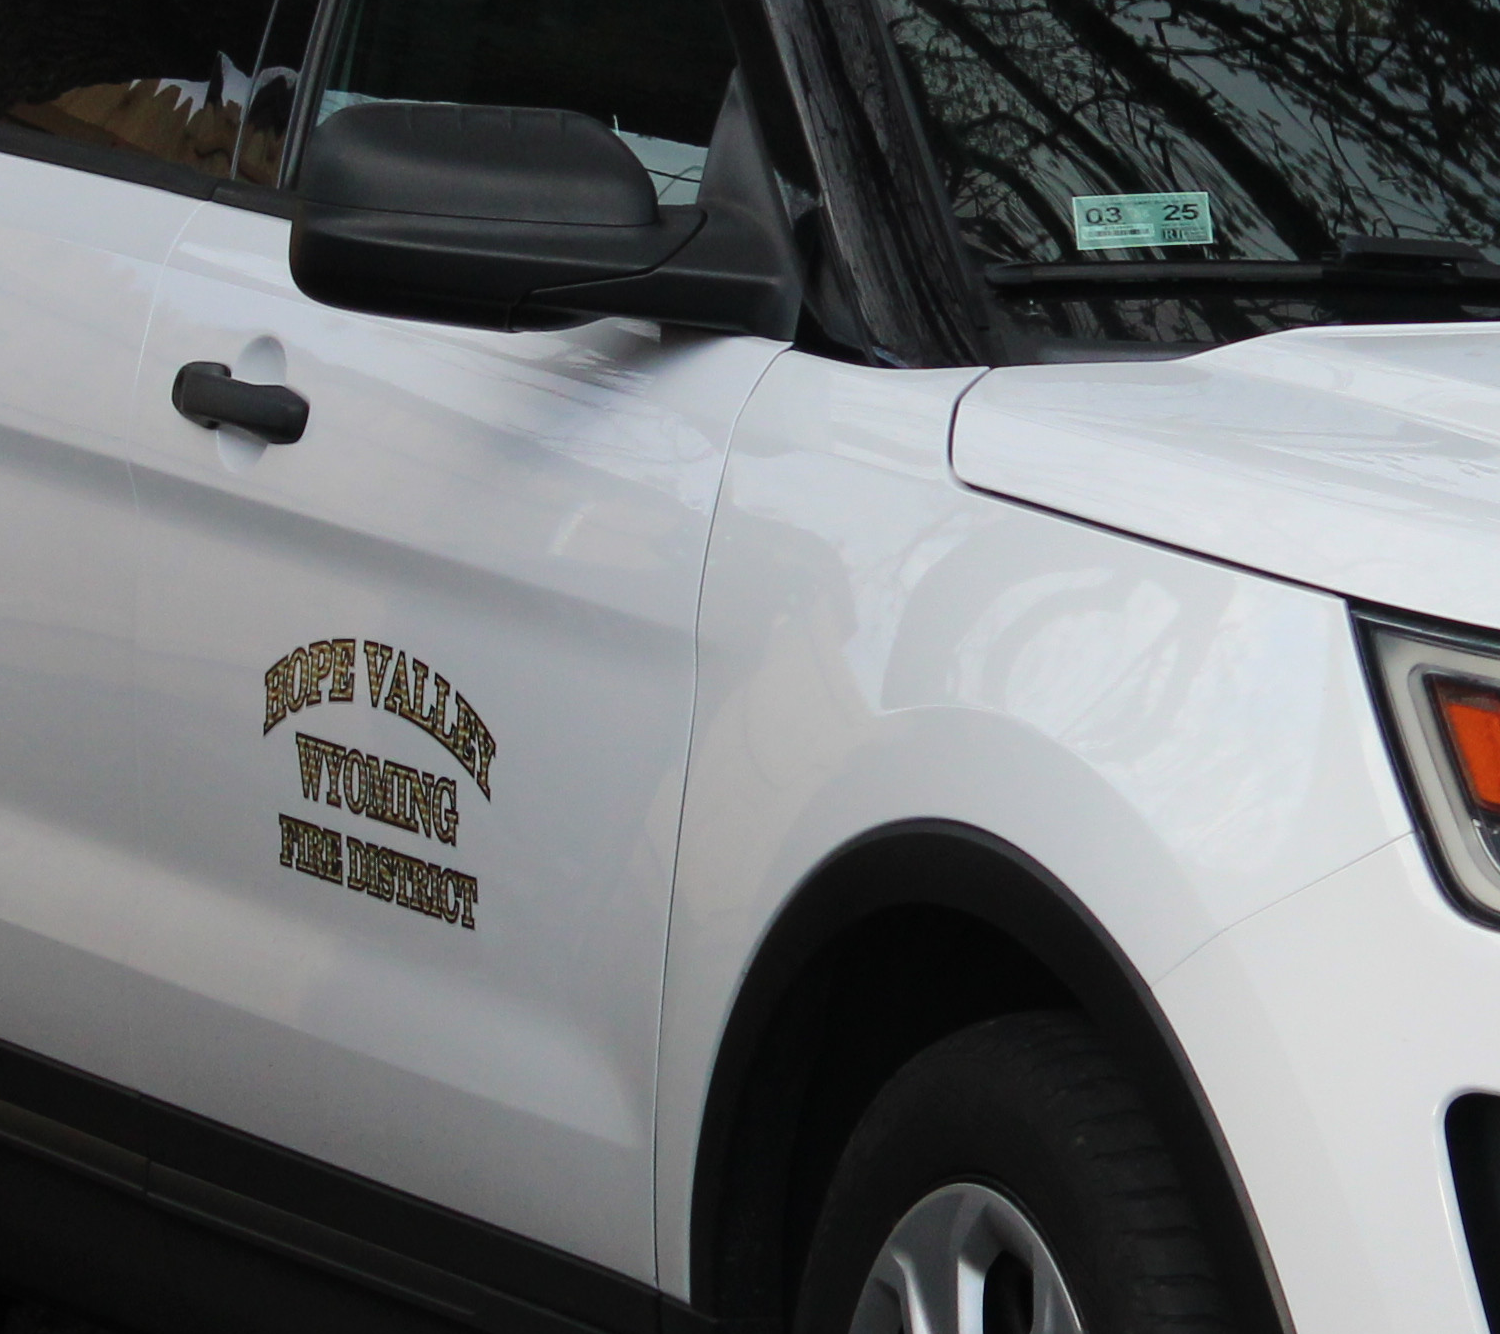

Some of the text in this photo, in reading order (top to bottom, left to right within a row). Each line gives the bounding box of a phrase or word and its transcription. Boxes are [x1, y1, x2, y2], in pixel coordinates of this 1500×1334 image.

[1163, 203, 1200, 221] 25
[263, 639, 497, 803] HOPE VALLEY
[295, 731, 459, 848] WYOMING
[278, 813, 479, 931] FIRE DISTRICT
